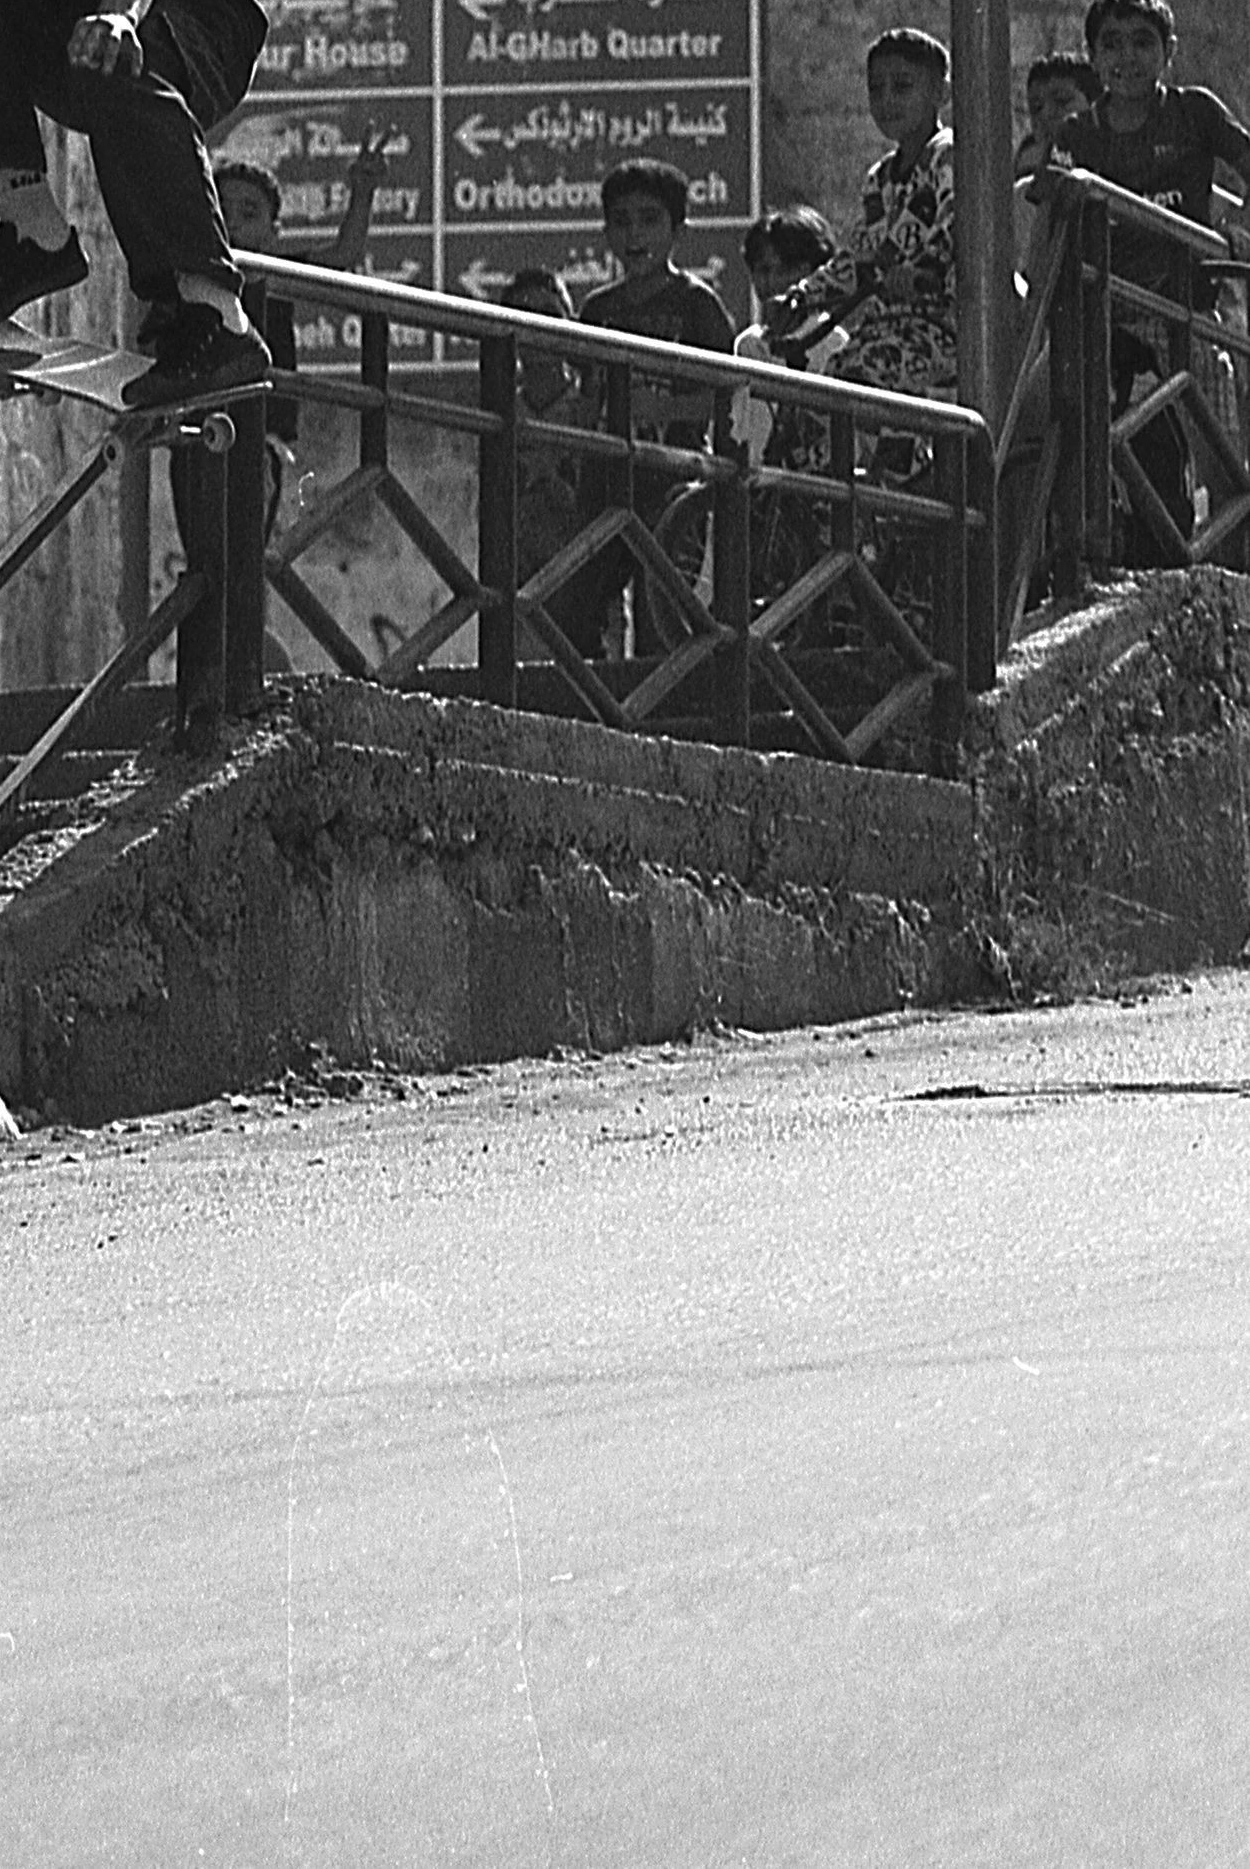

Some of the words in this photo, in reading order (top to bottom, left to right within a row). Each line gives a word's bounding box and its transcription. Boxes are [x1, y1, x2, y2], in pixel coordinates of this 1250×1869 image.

[304, 33, 408, 67] House
[607, 29, 723, 60] Quarter
[664, 101, 728, 146] كنيسة
[455, 175, 603, 211] Orthodox
